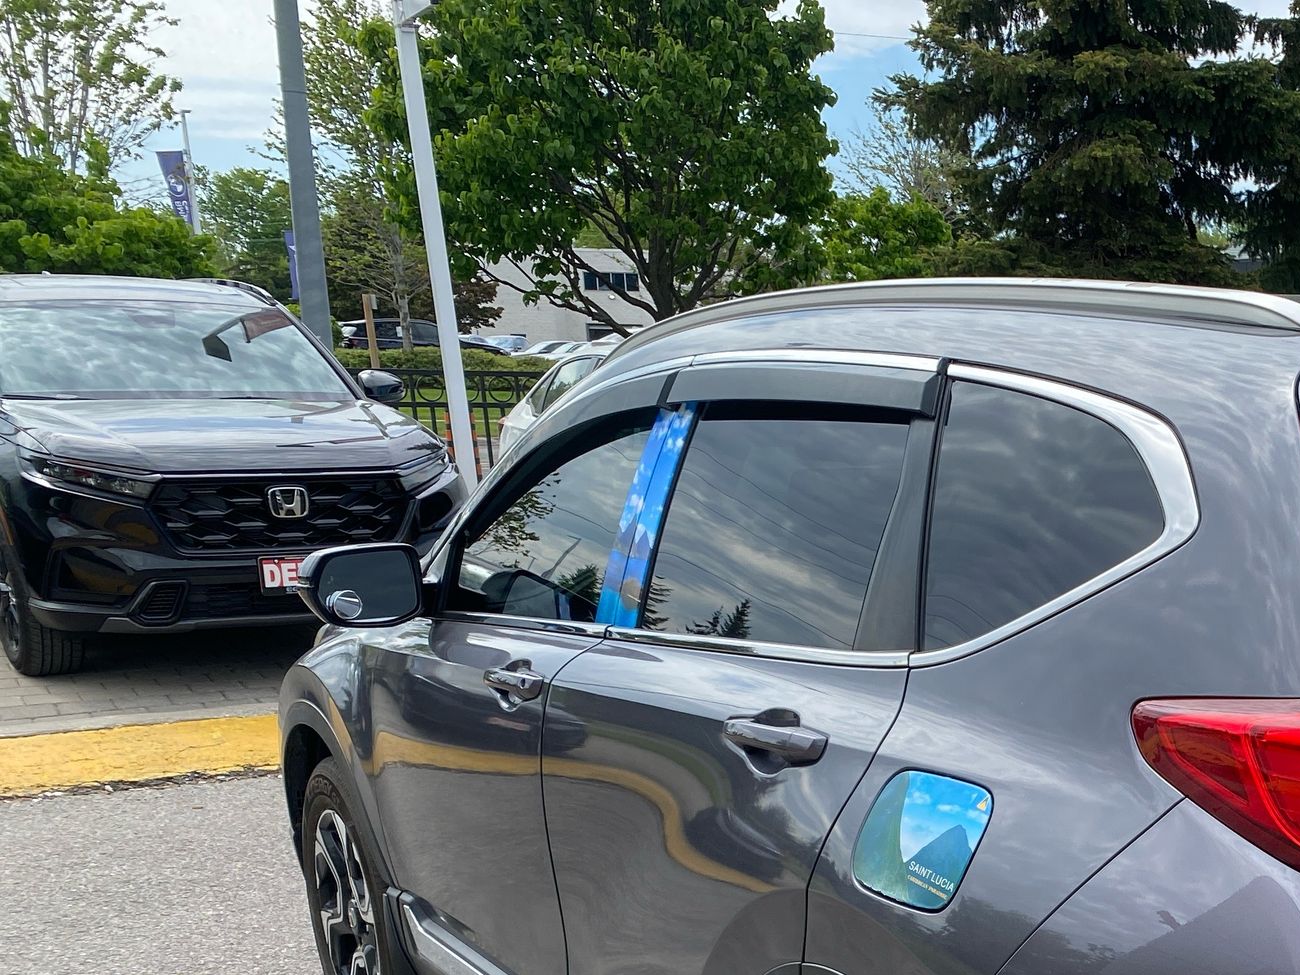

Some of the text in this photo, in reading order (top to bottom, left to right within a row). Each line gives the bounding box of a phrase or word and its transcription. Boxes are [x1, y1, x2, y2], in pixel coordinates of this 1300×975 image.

[262, 563, 303, 588] DE
[908, 860, 954, 893] SAINT LUCIA
